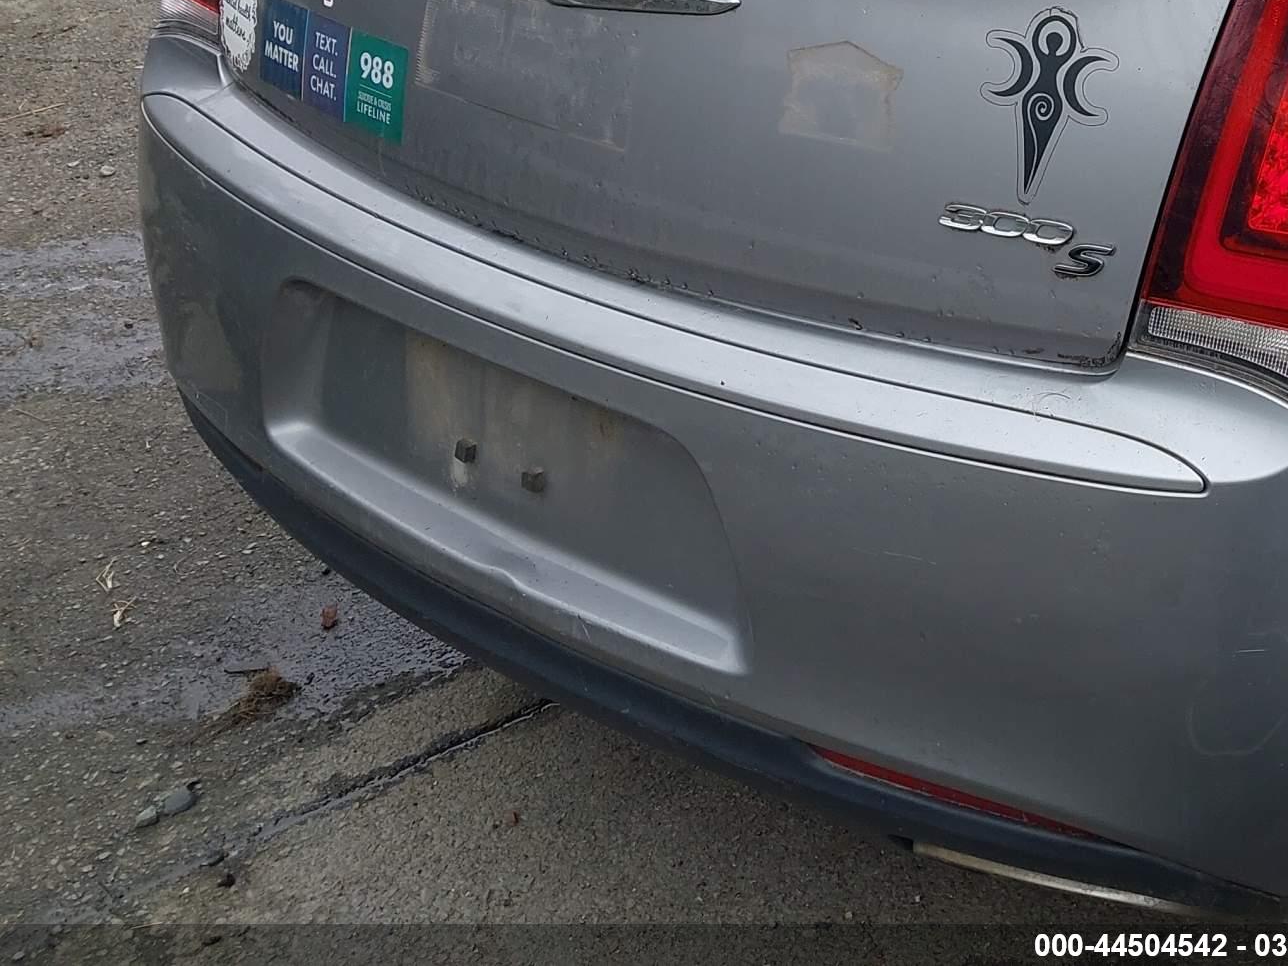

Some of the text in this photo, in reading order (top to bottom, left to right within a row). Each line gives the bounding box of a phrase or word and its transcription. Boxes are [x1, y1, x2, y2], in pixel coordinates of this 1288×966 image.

[273, 20, 293, 45] YOU
[315, 31, 338, 56] TEXT.
[264, 40, 299, 72] MATTER
[312, 54, 337, 79] CALL.
[360, 52, 394, 89] 988
[310, 75, 337, 101] CHAT.
[356, 102, 391, 125] LIFELINE
[938, 203, 1117, 277] 300 S
